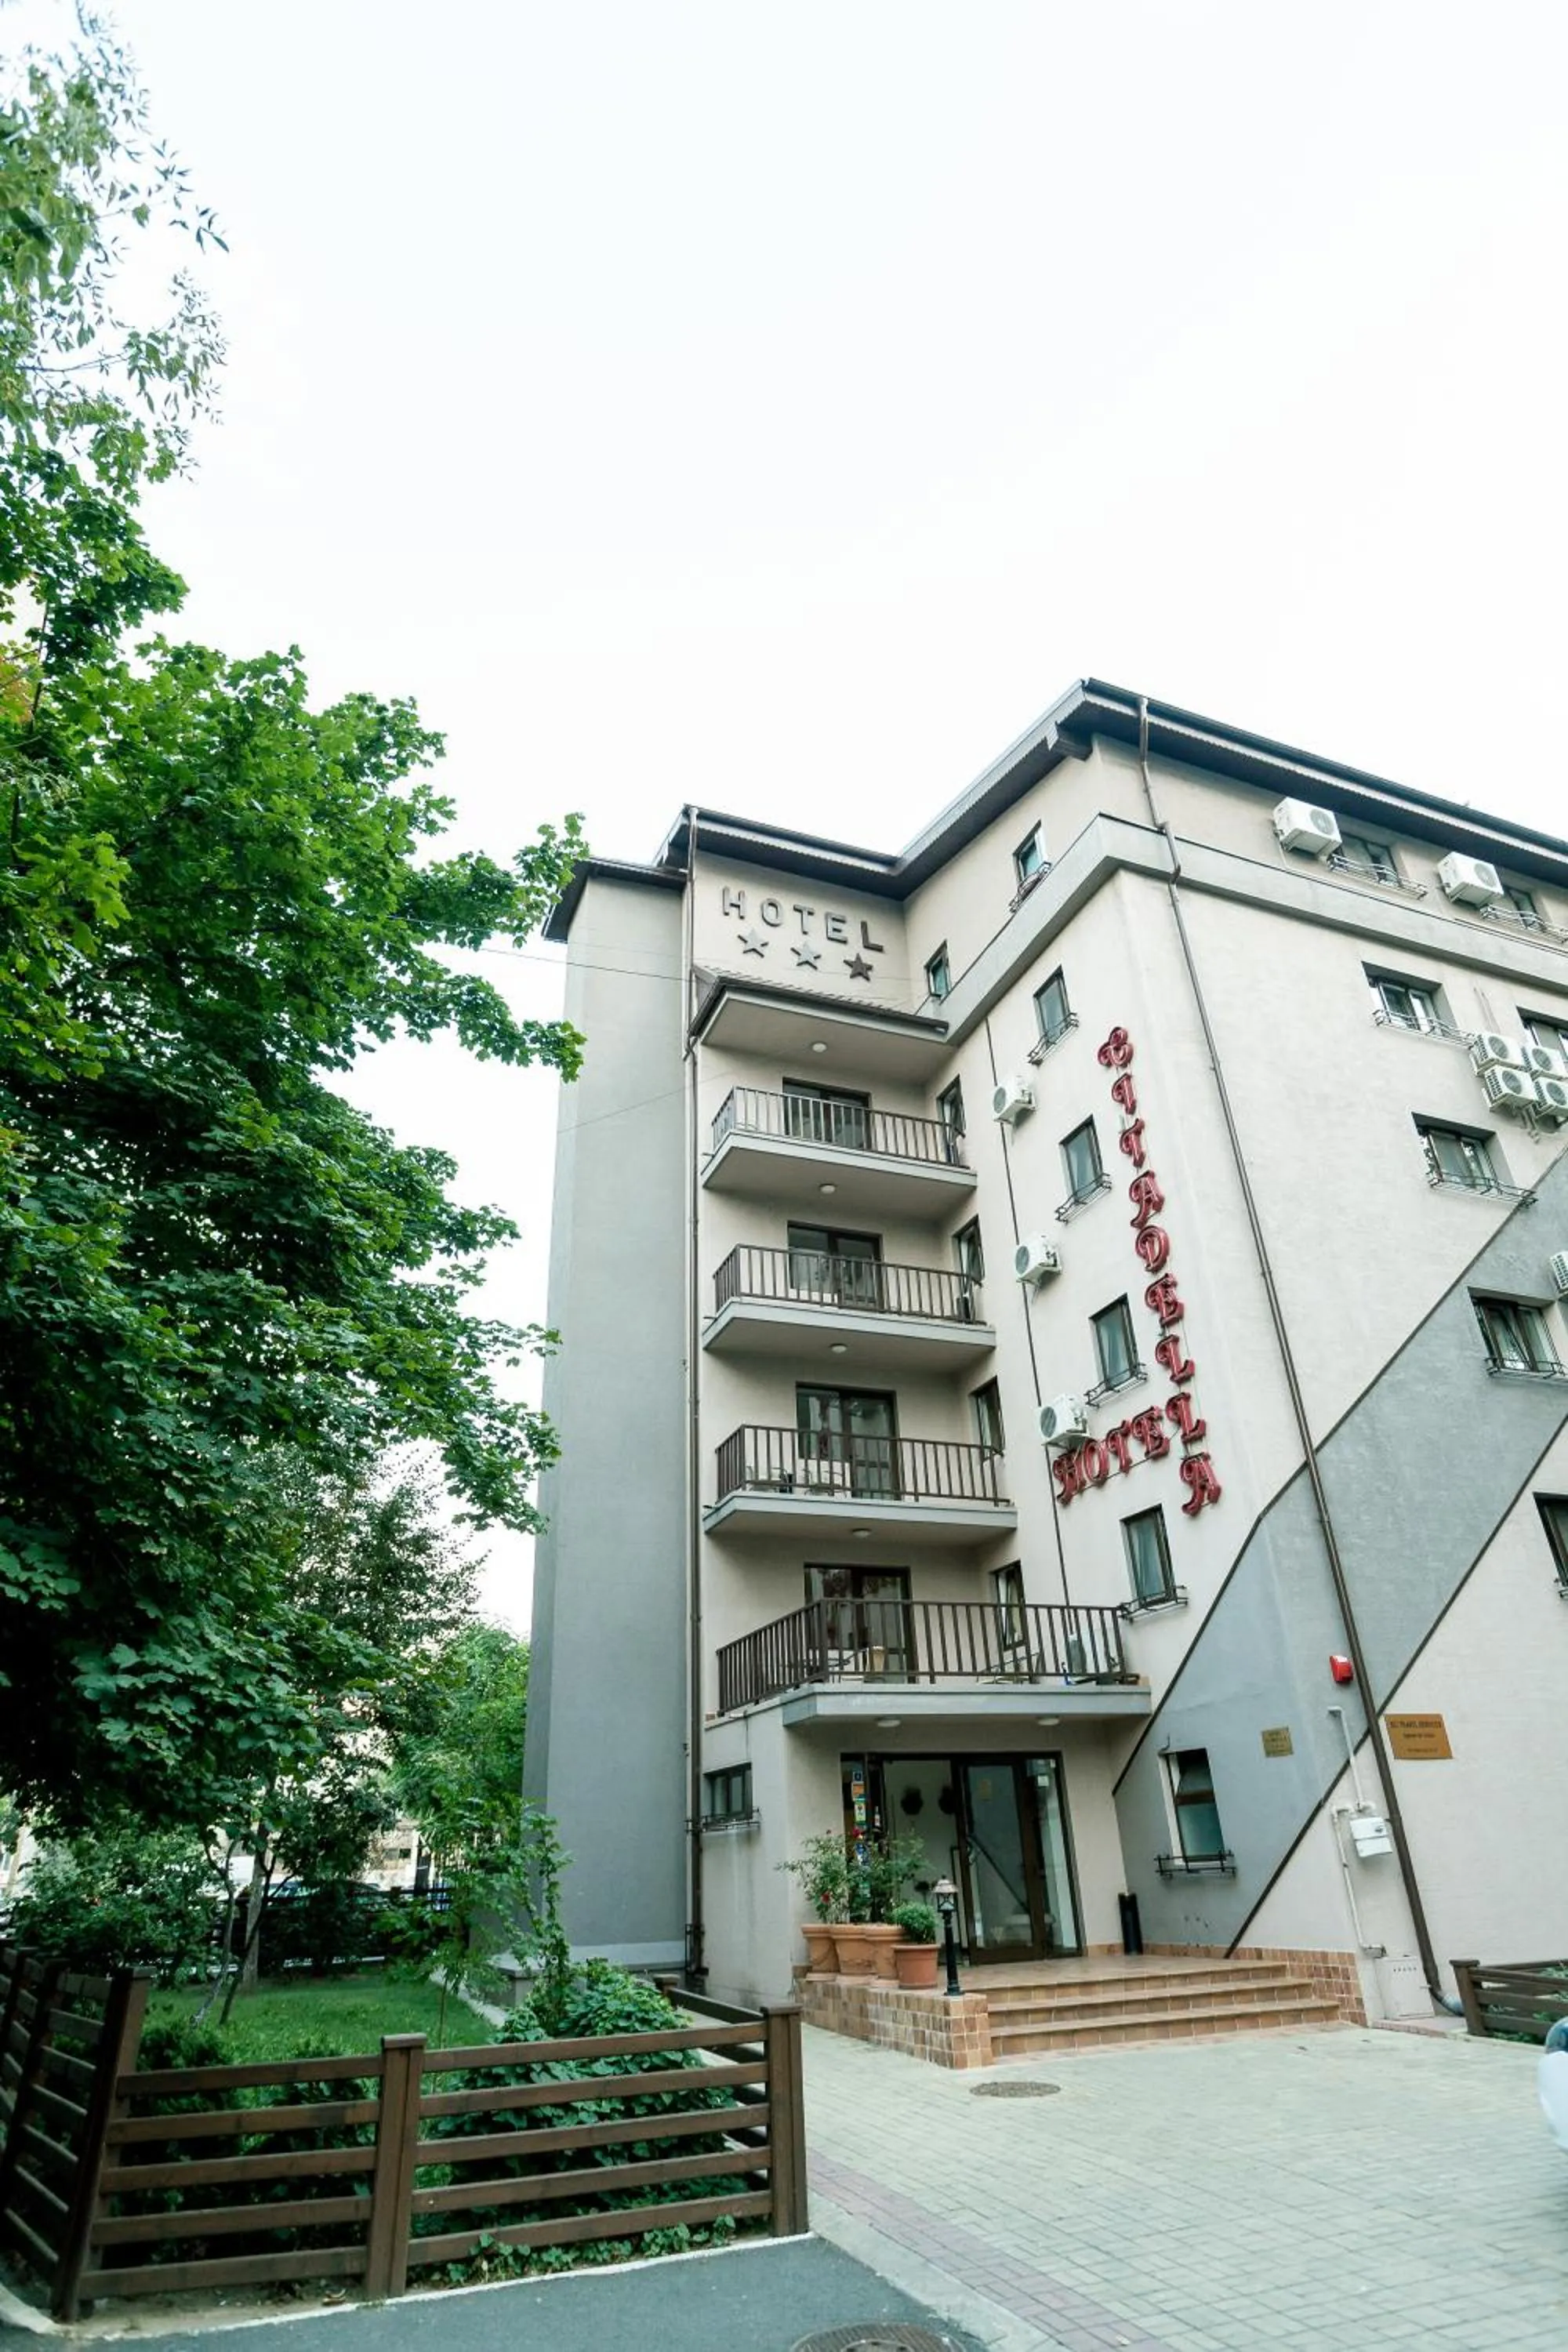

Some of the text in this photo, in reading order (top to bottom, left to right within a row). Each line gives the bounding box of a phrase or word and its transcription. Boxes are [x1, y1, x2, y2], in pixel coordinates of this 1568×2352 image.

[722, 887, 884, 952] HOTEL
[1098, 1026, 1221, 1516] CITADELLA
[1052, 1392, 1207, 1505] HOTEL
